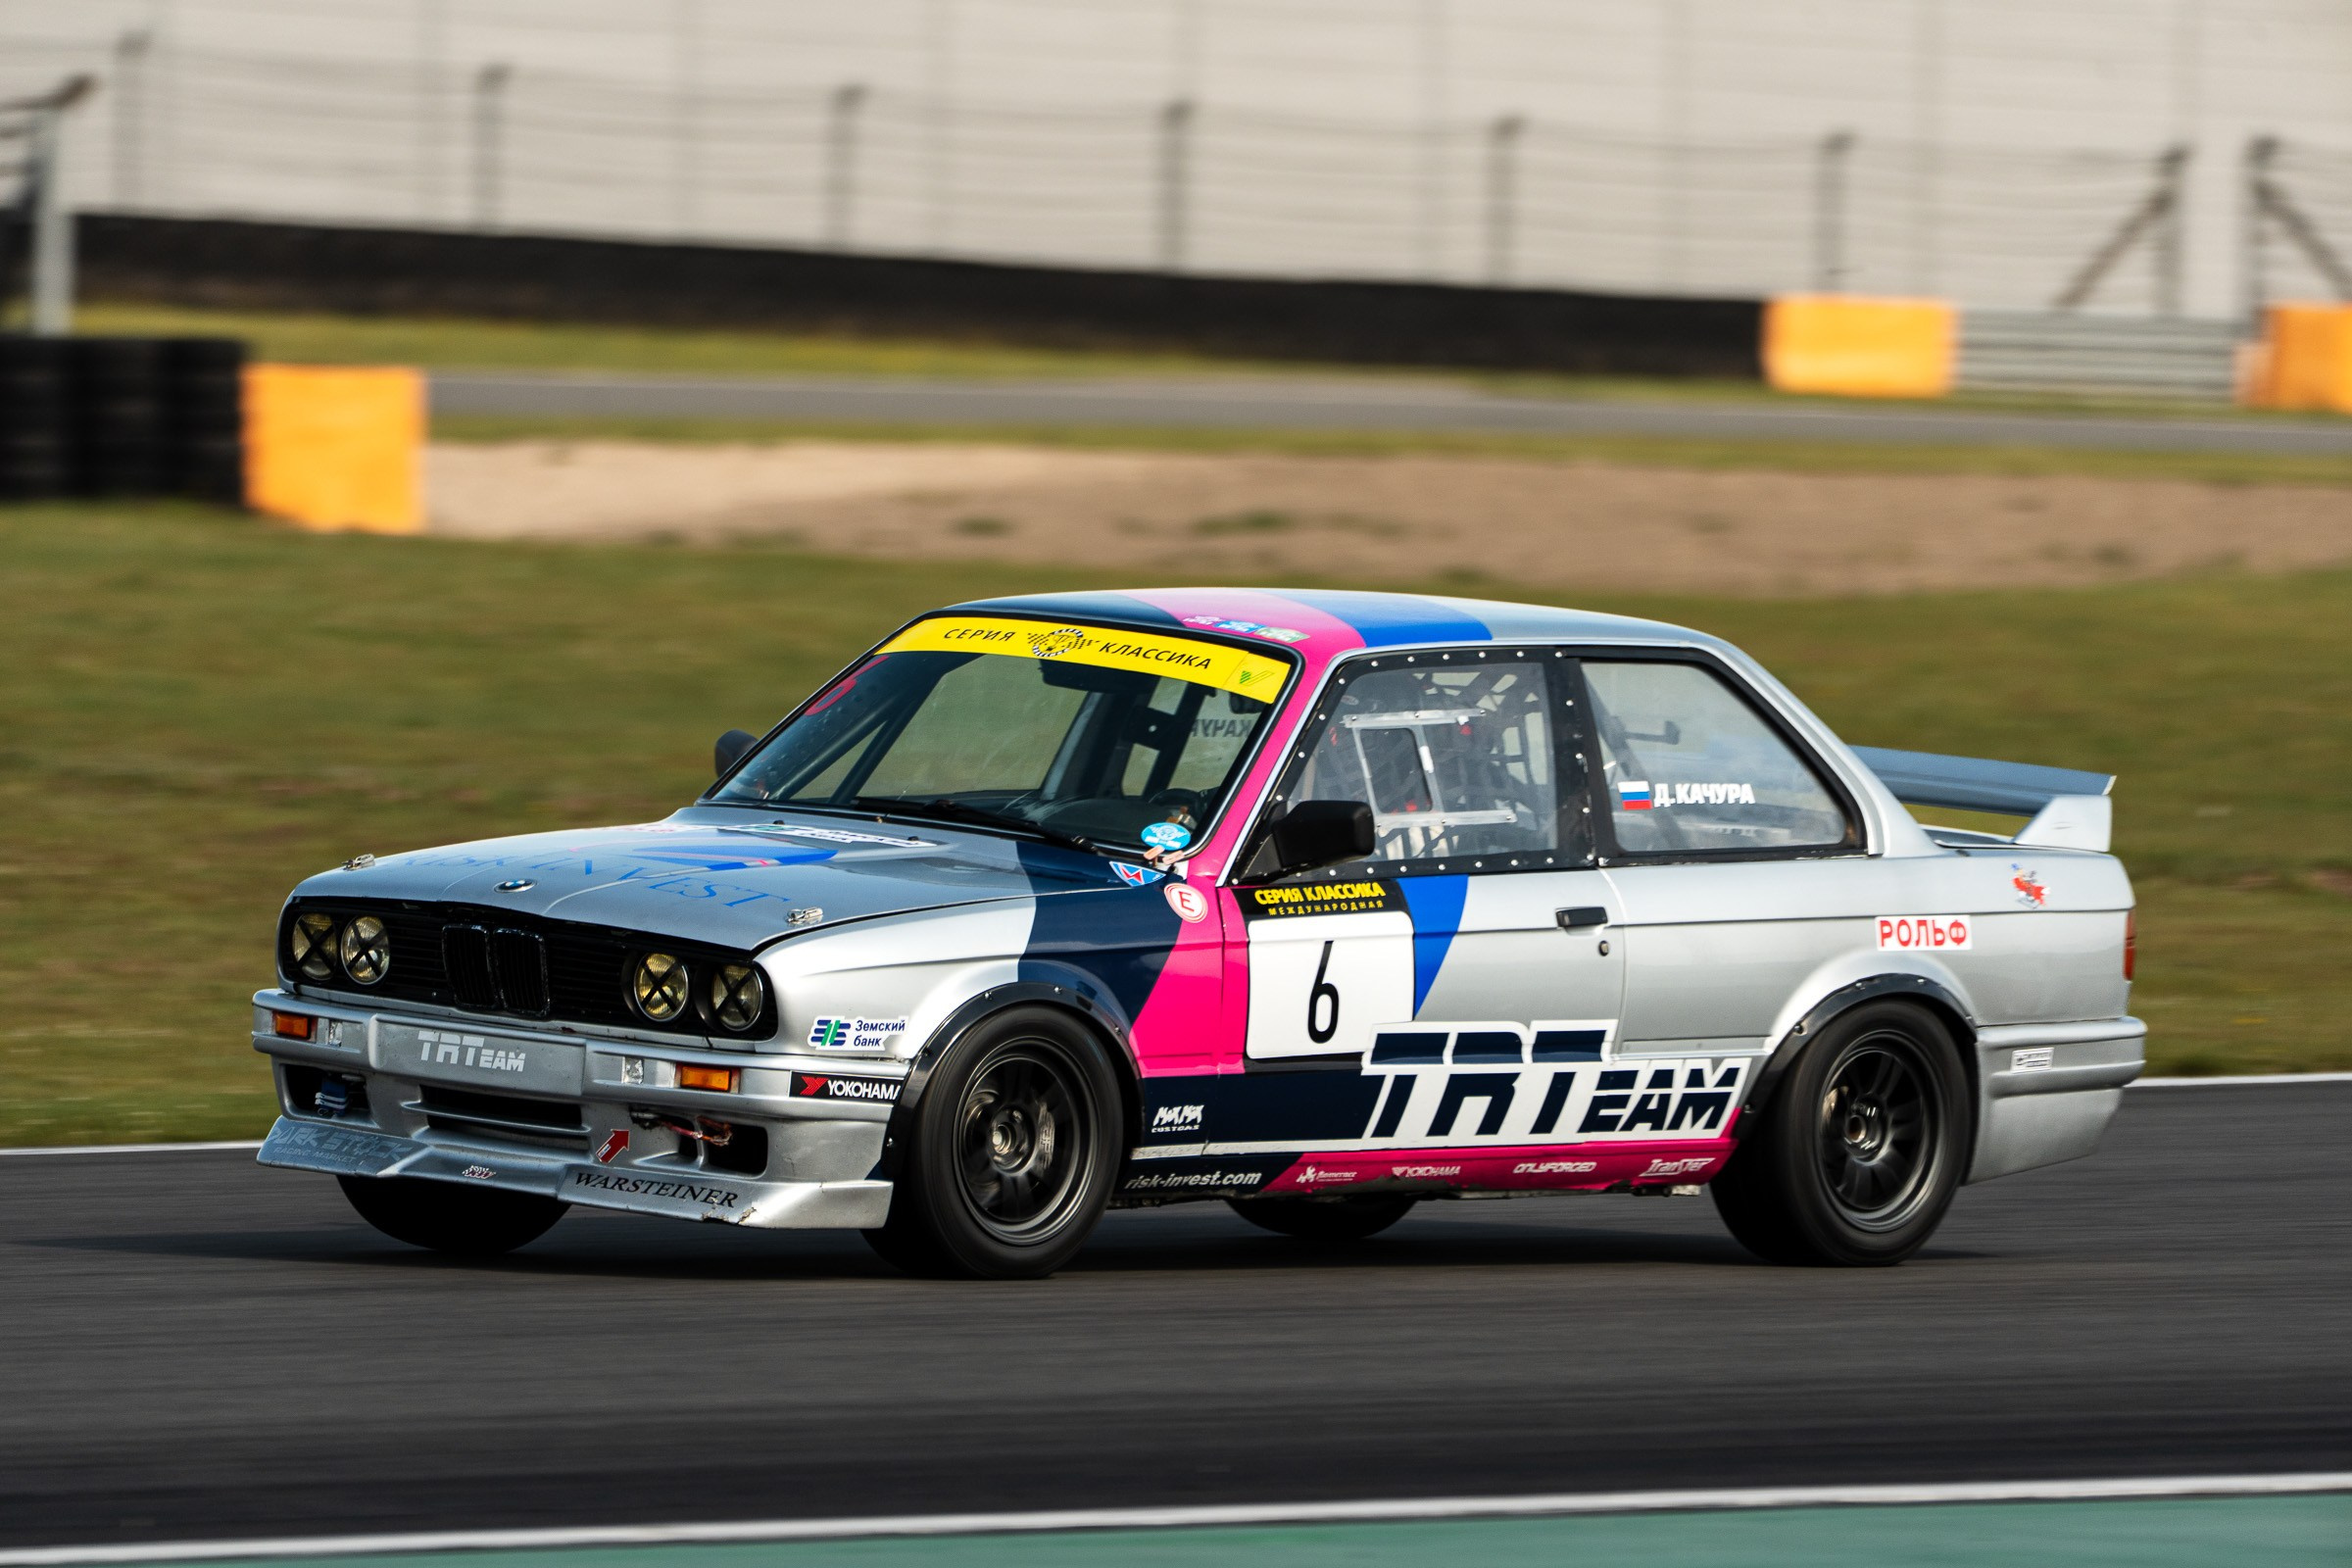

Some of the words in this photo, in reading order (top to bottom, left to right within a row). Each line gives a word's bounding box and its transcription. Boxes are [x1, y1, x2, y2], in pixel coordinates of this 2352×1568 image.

[943, 628, 1016, 642] СЕРИЯ
[1099, 642, 1211, 670] КЛАССИКА
[1653, 783, 1756, 808] Д.КАЧУРА
[1178, 891, 1195, 912] E
[1254, 888, 1304, 906] СЕРИЯ
[1302, 882, 1387, 902] КЛАССИКА
[1267, 900, 1384, 916] МЕЖДУНАРОДНАЯ
[1880, 919, 1967, 947] РОЛЬФ
[1307, 940, 1340, 1044] 6
[855, 1019, 906, 1032] Земский
[854, 1034, 882, 1047] банк
[575, 1171, 738, 1208] WARSTEINER
[1124, 1170, 1262, 1190] risk-invest.com
